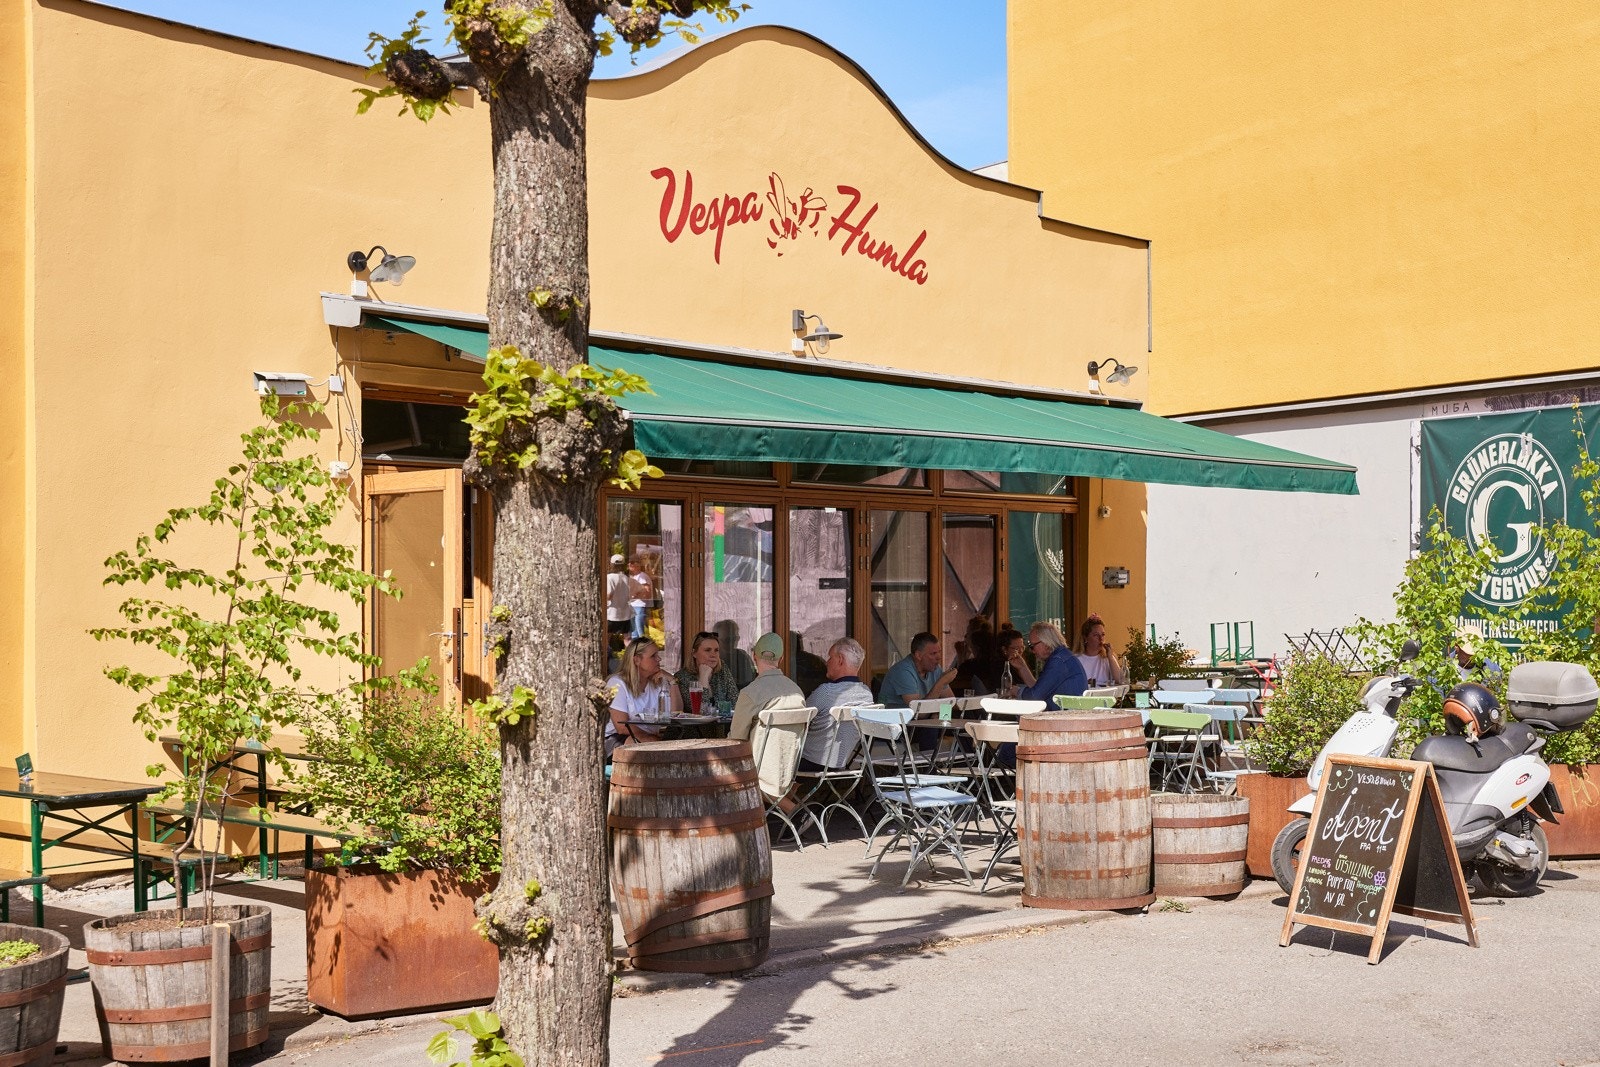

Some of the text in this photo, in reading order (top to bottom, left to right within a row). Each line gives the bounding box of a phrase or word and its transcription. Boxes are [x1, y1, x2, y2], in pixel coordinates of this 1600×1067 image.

[650, 167, 928, 285] Vespa Humla
[1431, 402, 1470, 416] MUGA
[1471, 480, 1537, 563] G
